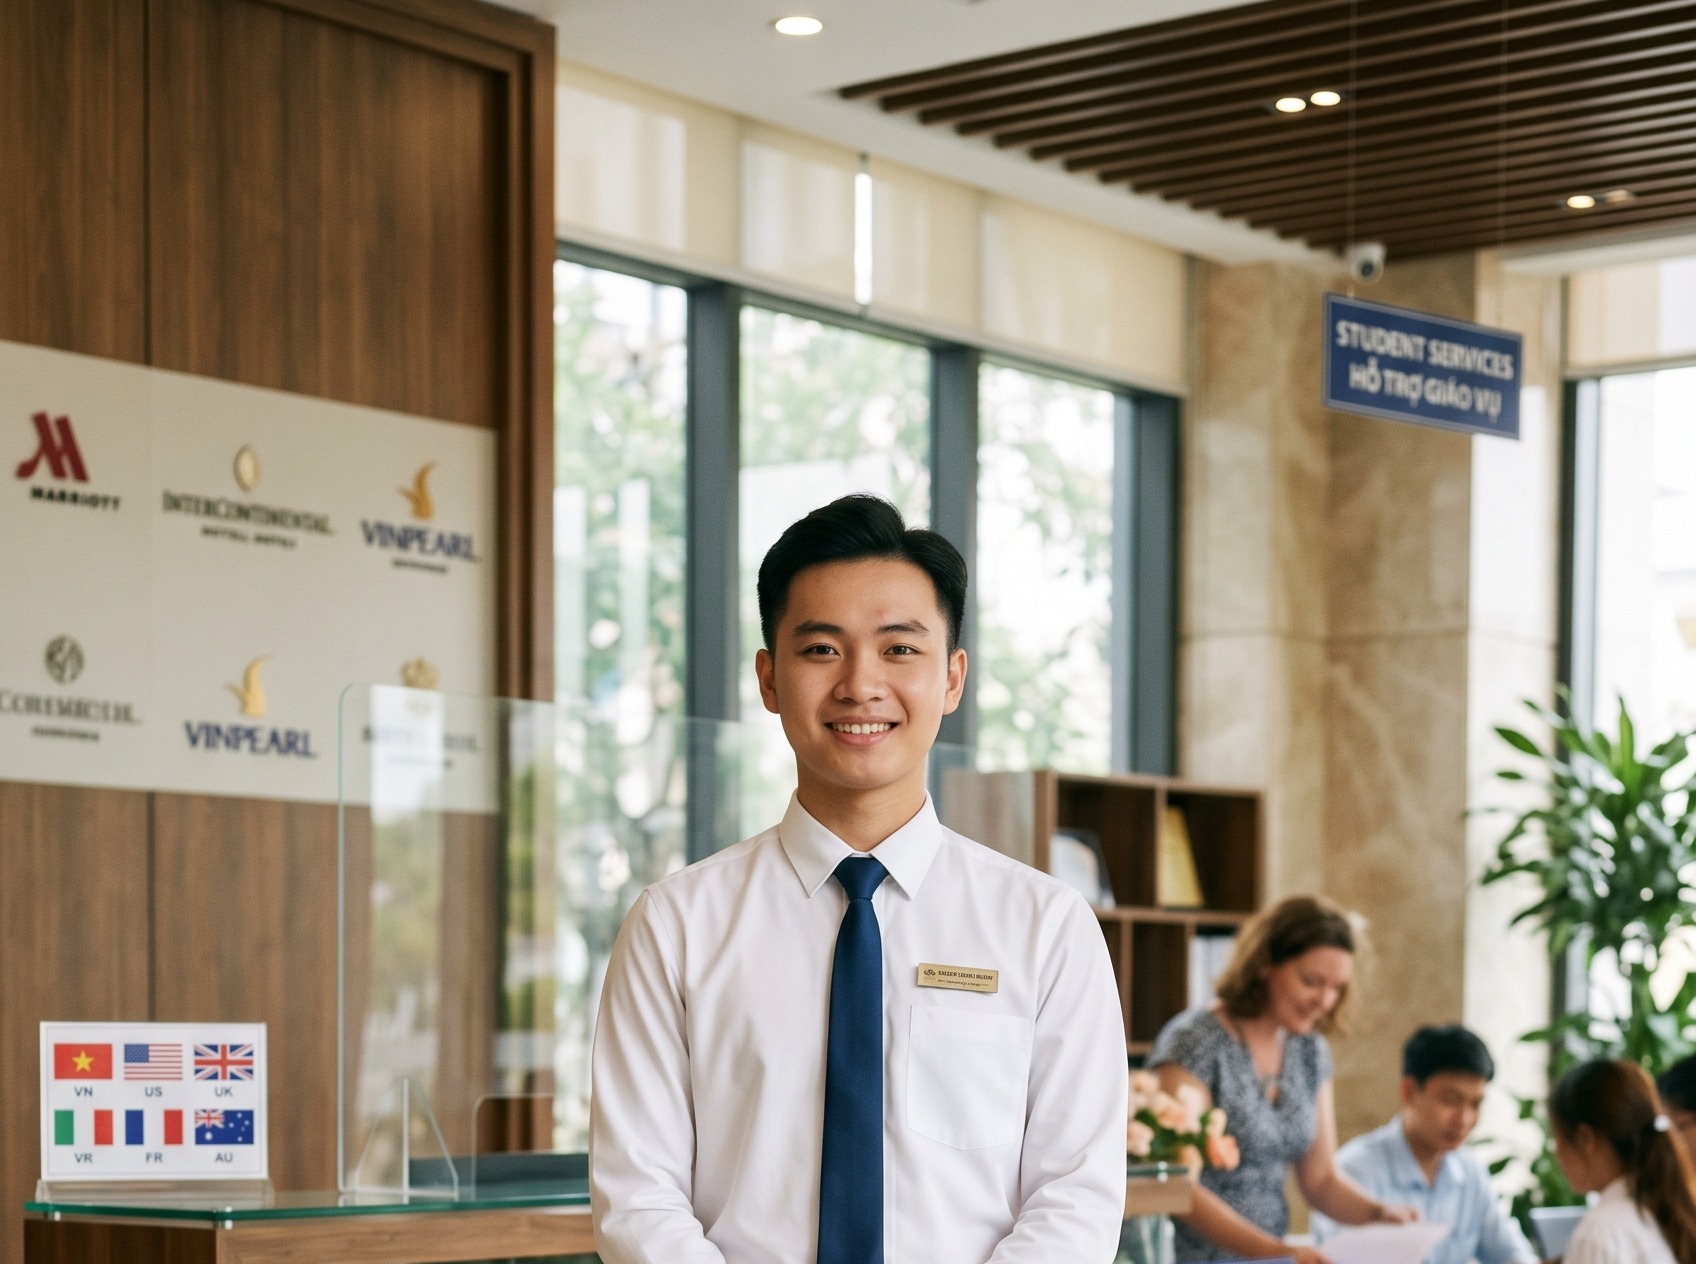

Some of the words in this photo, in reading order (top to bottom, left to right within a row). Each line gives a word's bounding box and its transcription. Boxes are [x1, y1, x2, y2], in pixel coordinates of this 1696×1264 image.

[1336, 320, 1425, 363] STUDENT
[1428, 339, 1515, 380] SERVICES
[1424, 376, 1473, 411] GIÁO
[31, 487, 120, 510] MARRIOTT
[361, 519, 479, 562] VINPEARL
[184, 720, 318, 758] VINPEARL
[74, 1086, 93, 1097] VN
[144, 1086, 163, 1097] US
[214, 1086, 234, 1097] UK
[74, 1153, 93, 1163] VR
[146, 1153, 163, 1163] FR
[214, 1152, 233, 1163] AU
